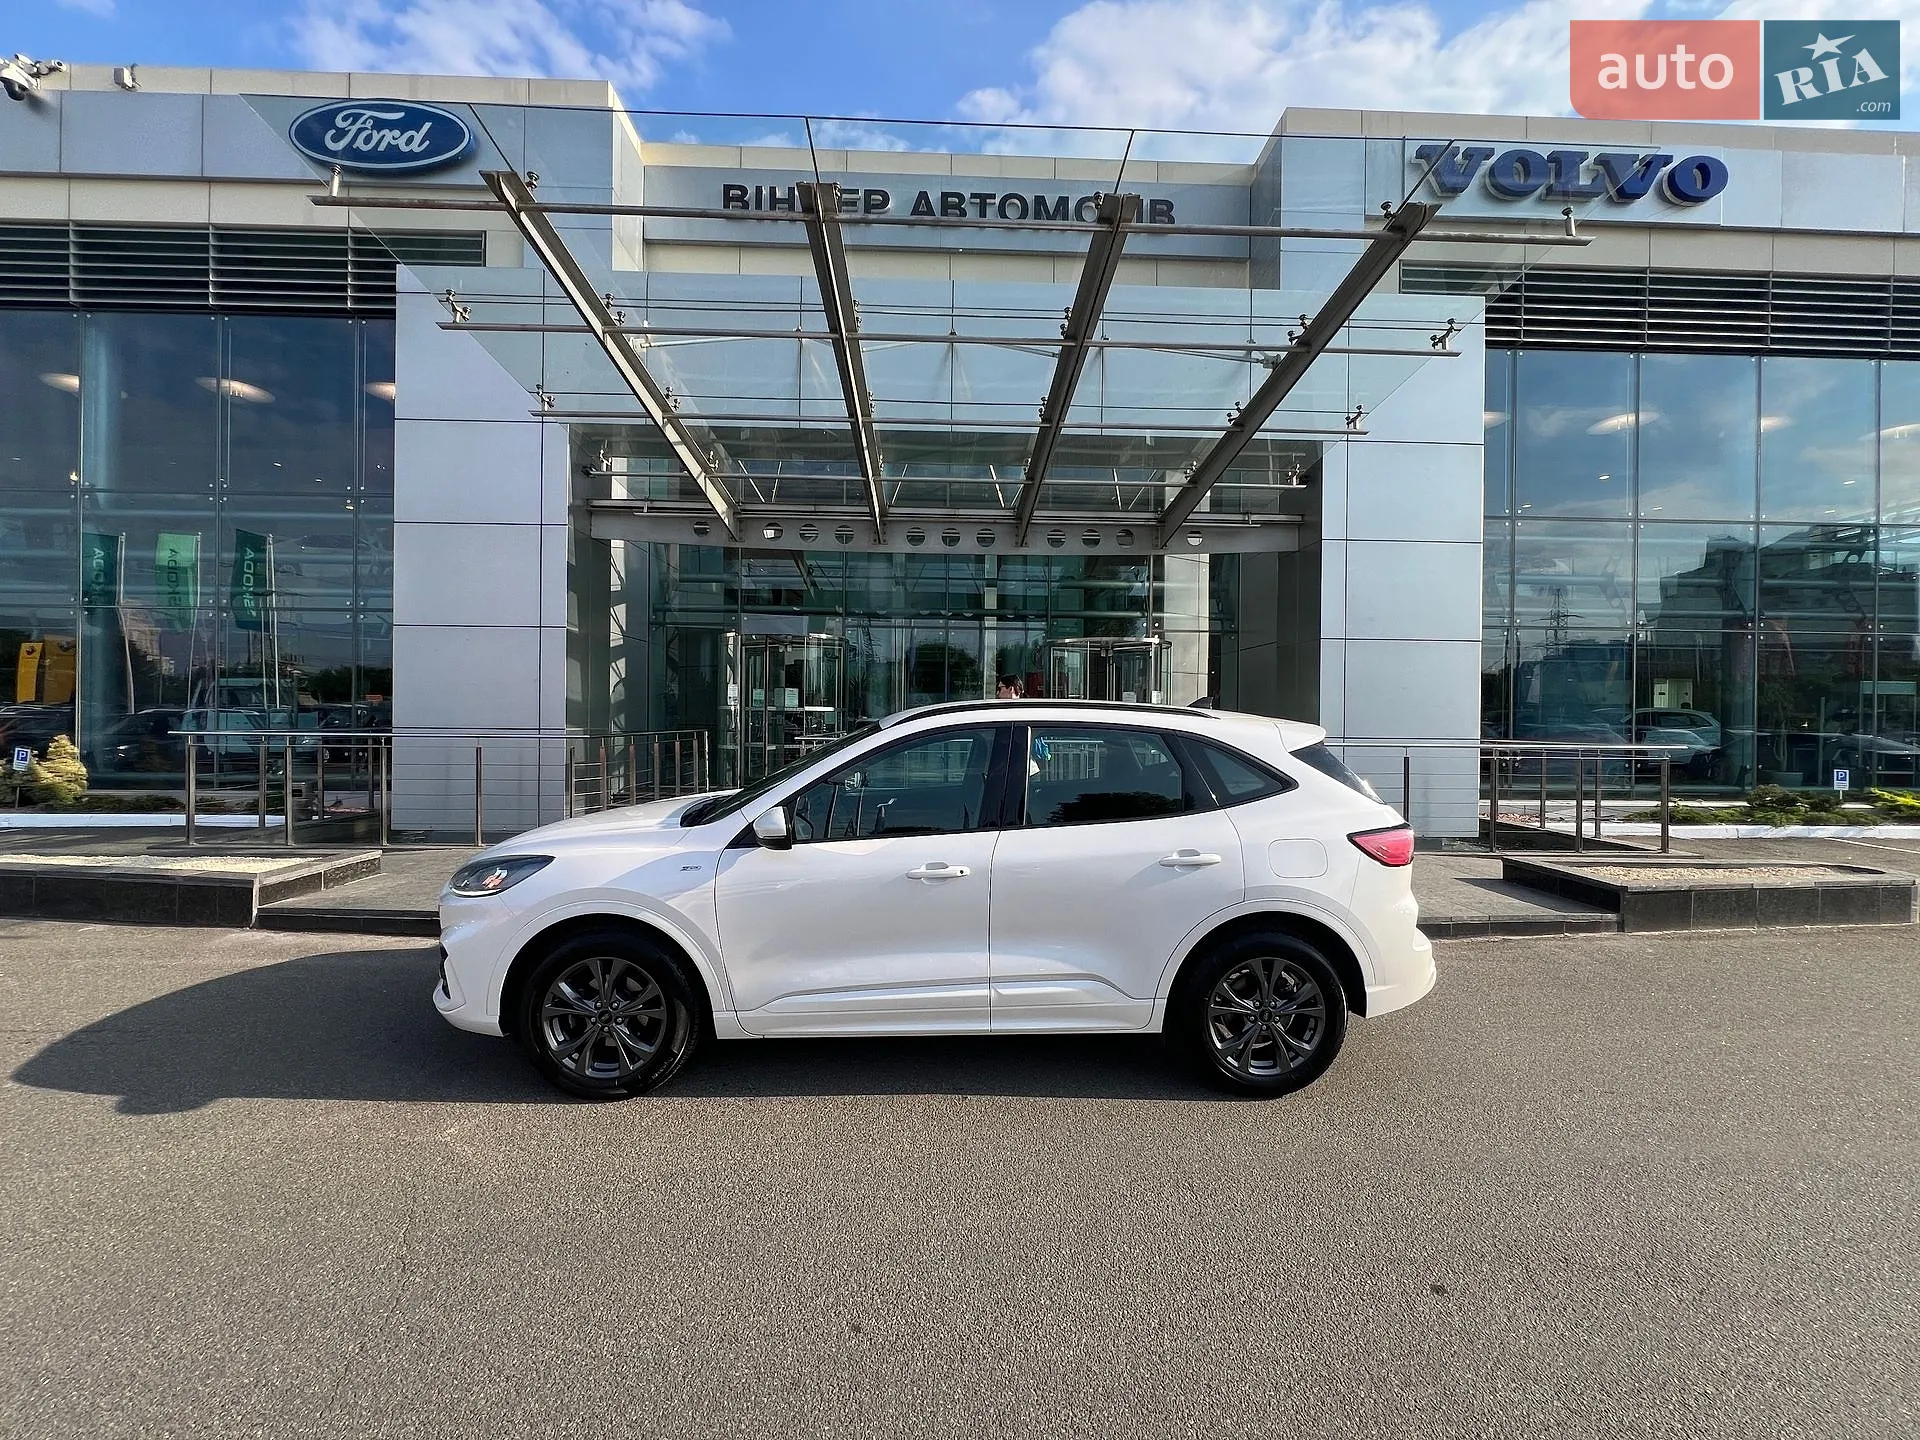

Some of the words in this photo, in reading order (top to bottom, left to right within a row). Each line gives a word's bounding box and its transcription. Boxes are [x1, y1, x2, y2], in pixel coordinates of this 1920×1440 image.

[323, 107, 434, 154] Ford
[1411, 144, 1729, 206] VOLVO
[722, 183, 891, 214] ВІНЕР
[909, 190, 1176, 225] АВТОМОІВ
